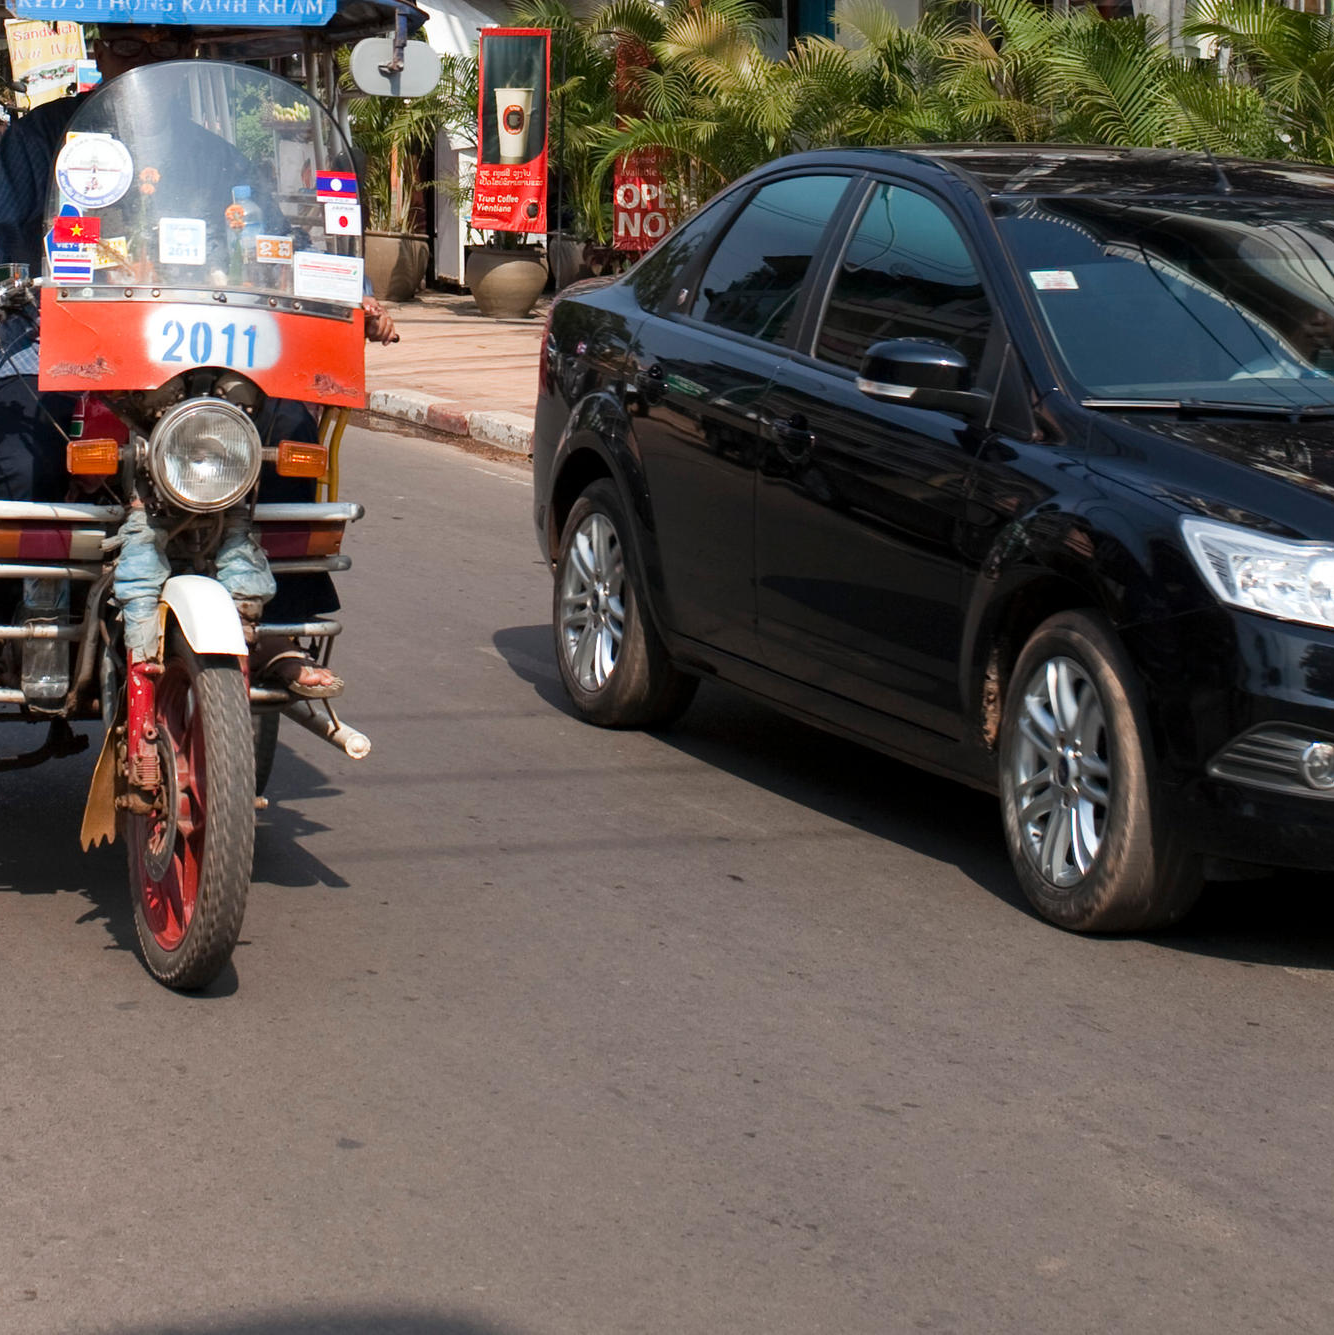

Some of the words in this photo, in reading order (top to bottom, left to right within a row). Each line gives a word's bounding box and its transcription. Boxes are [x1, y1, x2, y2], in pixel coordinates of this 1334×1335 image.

[12, 23, 77, 42] Sandwich
[478, 194, 496, 203] True
[497, 194, 519, 203] Coffee
[616, 183, 676, 209] OPE
[476, 204, 512, 213] Vientiane
[617, 211, 667, 237] NO
[167, 246, 199, 258] 2011
[161, 319, 258, 368] 2011
